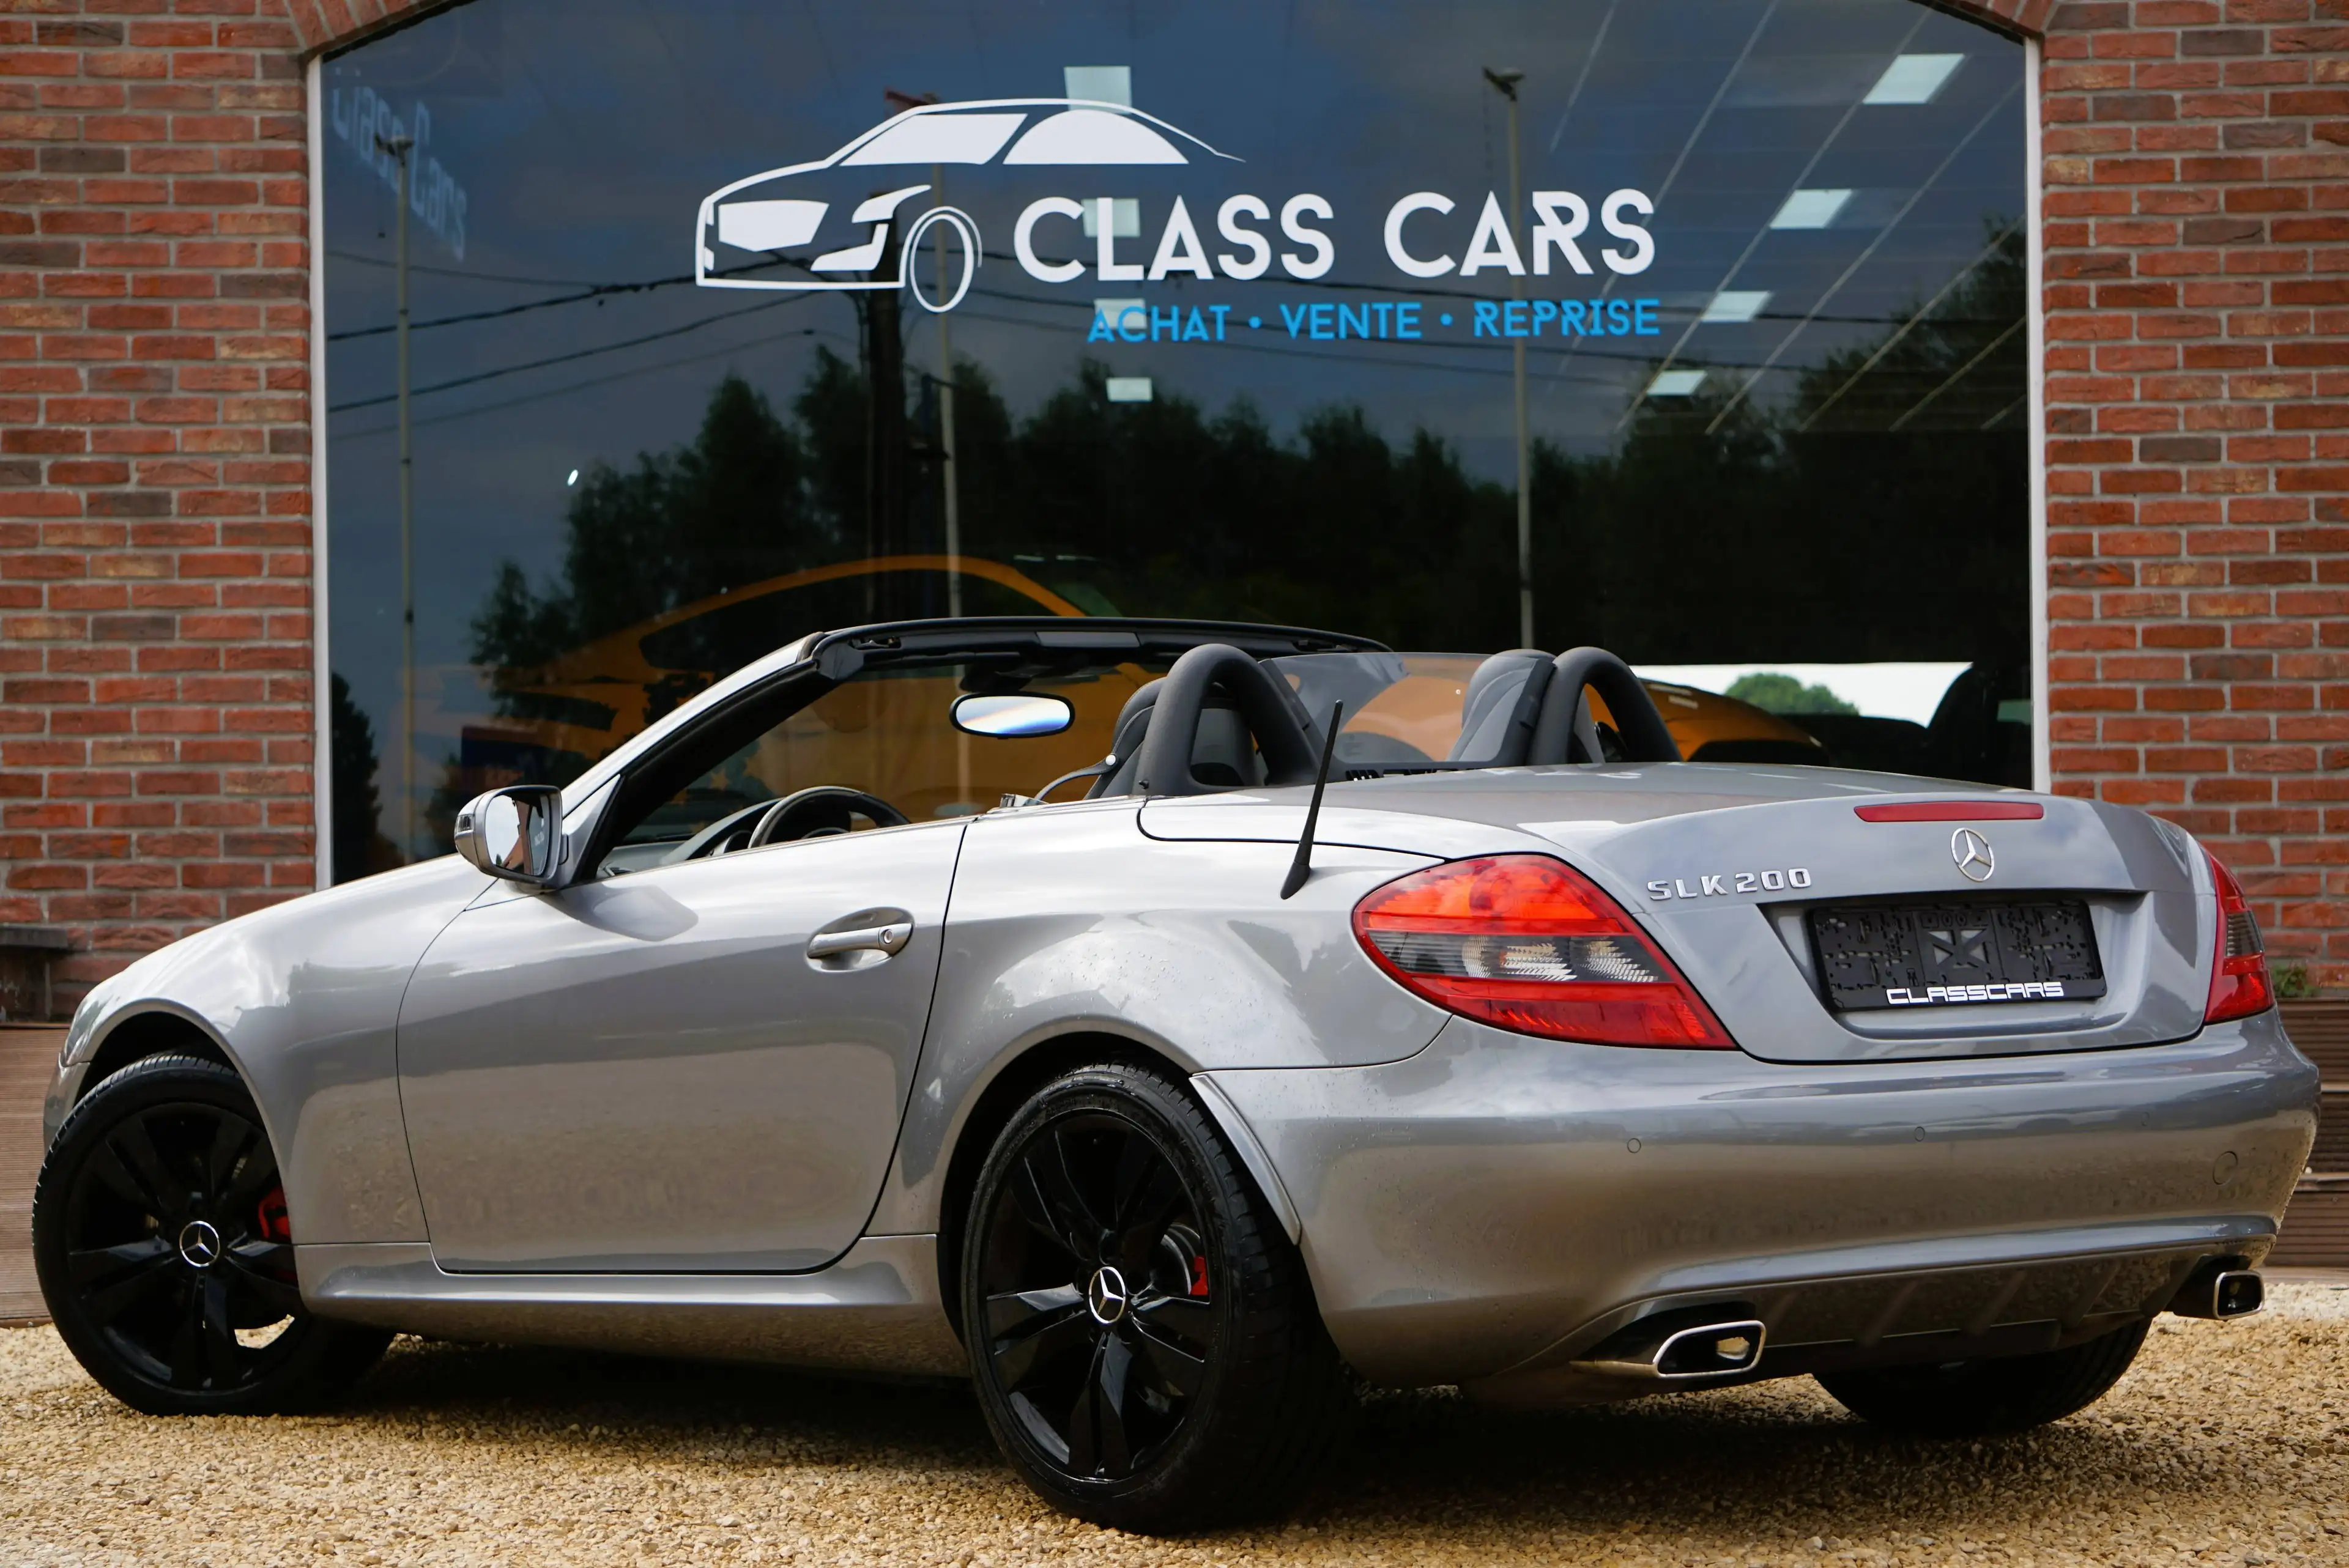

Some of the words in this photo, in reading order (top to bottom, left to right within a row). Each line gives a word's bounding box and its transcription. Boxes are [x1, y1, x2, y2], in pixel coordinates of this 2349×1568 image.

[1014, 193, 1335, 283] CLASS
[1384, 188, 1655, 278] CARS
[1086, 304, 1232, 344] ACHAT
[1278, 301, 1423, 341] VENTE
[1473, 297, 1661, 338] REPRISE
[1885, 981, 2065, 1005] CLASSCARS
